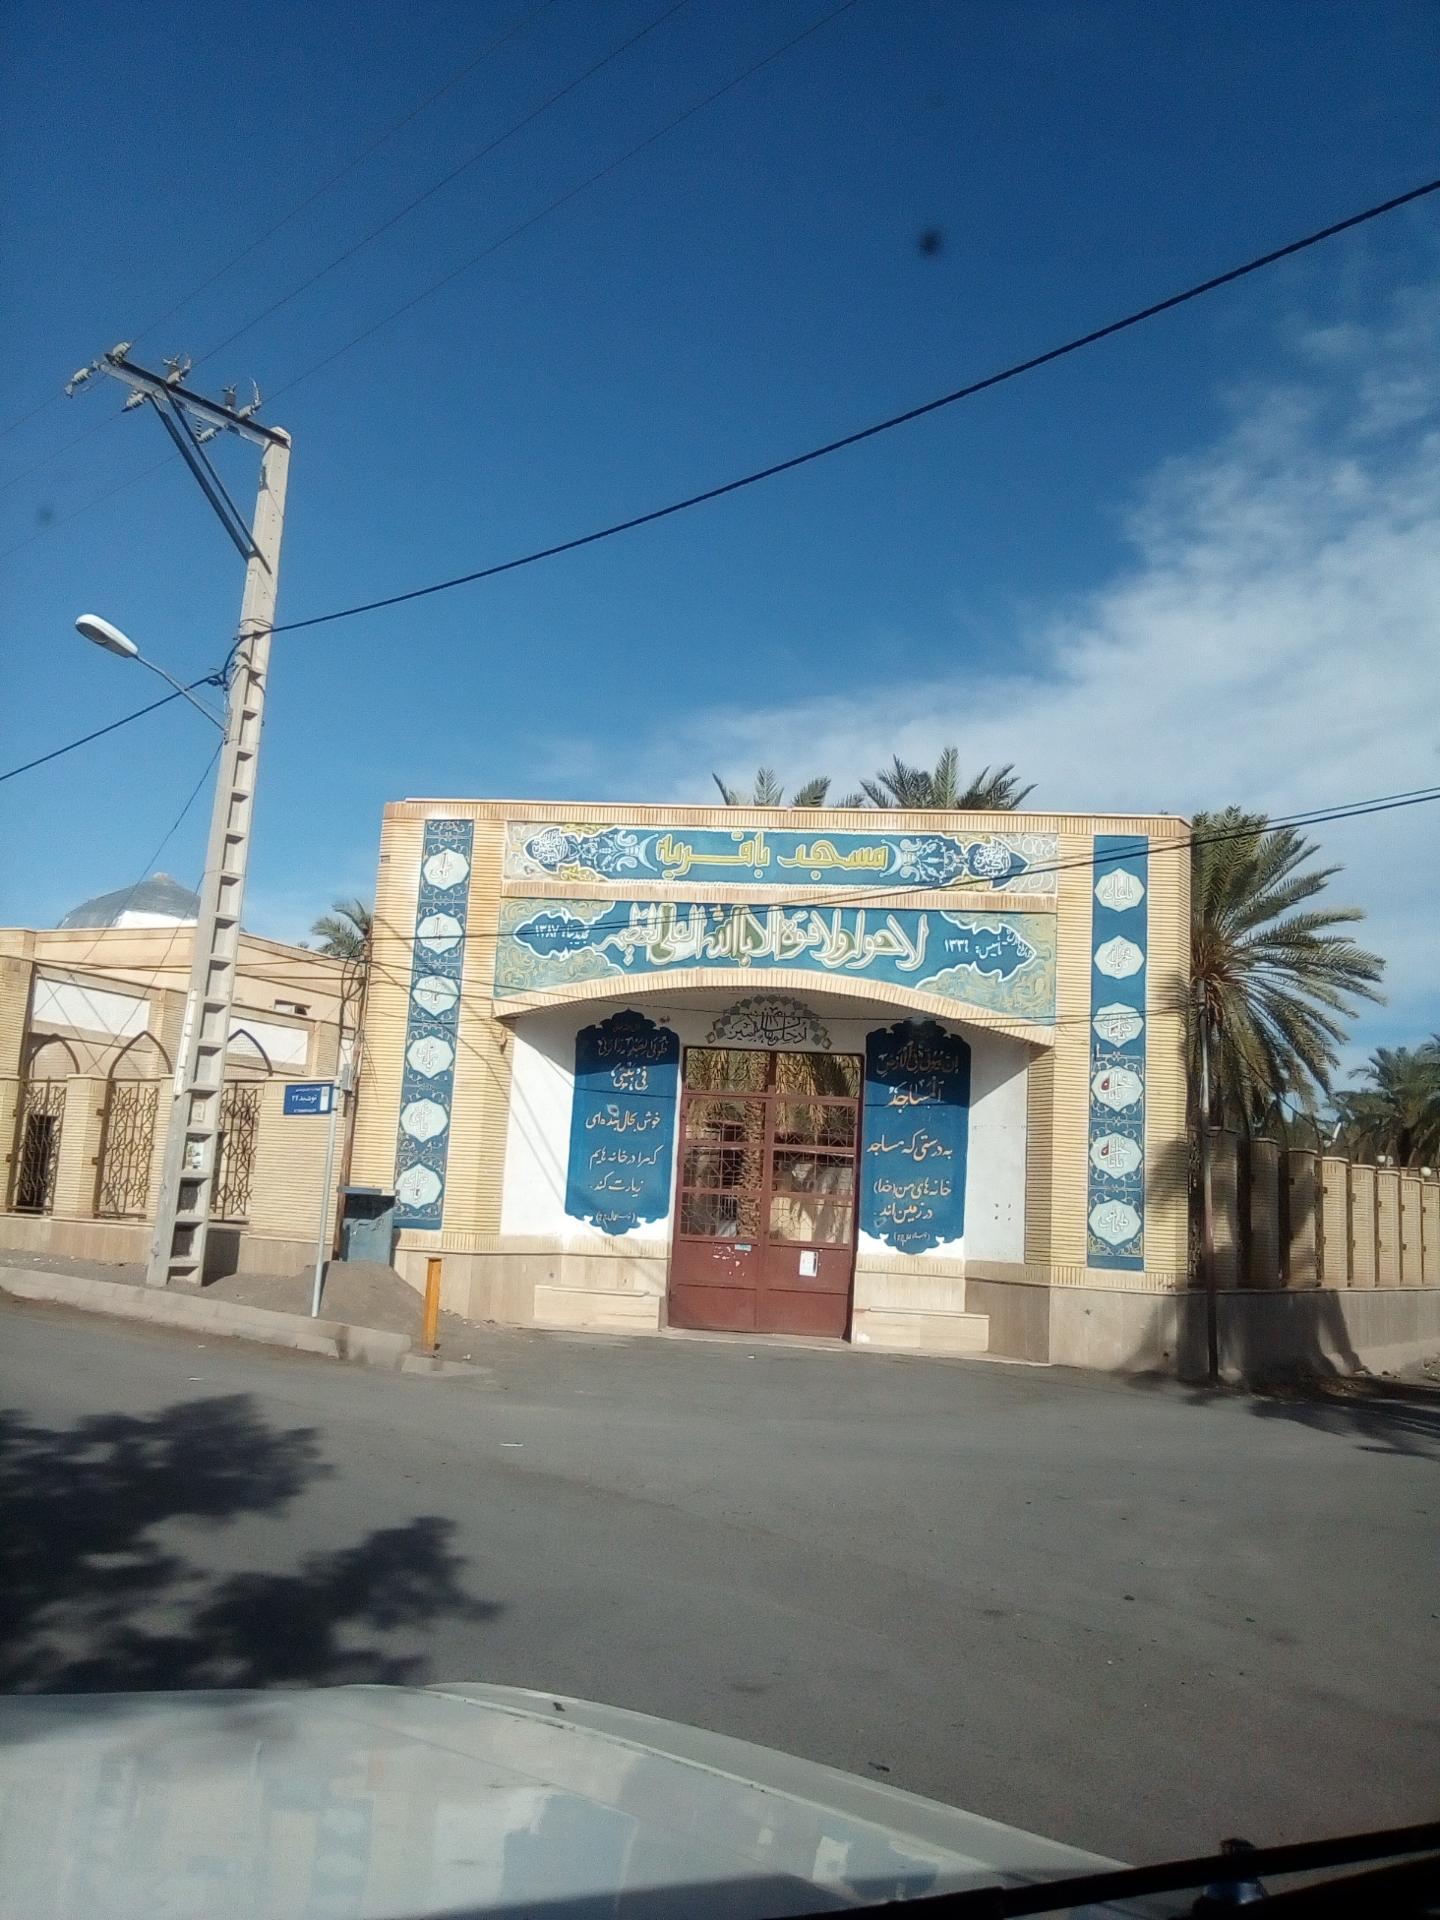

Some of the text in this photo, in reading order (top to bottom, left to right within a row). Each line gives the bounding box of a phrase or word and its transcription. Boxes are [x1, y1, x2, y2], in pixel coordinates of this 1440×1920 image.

[777, 839, 890, 881] مسجد
[637, 1111, 661, 1131] خوش
[866, 1134, 905, 1156] مساجد
[901, 1128, 926, 1154] که
[608, 1148, 628, 1163] خانه
[626, 1154, 636, 1165] در
[637, 1151, 650, 1168] مرا
[648, 1144, 664, 1165] که
[608, 1176, 644, 1197] زیارت
[873, 1178, 896, 1195] (خدا)
[895, 1183, 914, 1198] من
[929, 1179, 952, 1196] خانه
[893, 1202, 925, 1224] زمین
[922, 1208, 934, 1220] در
